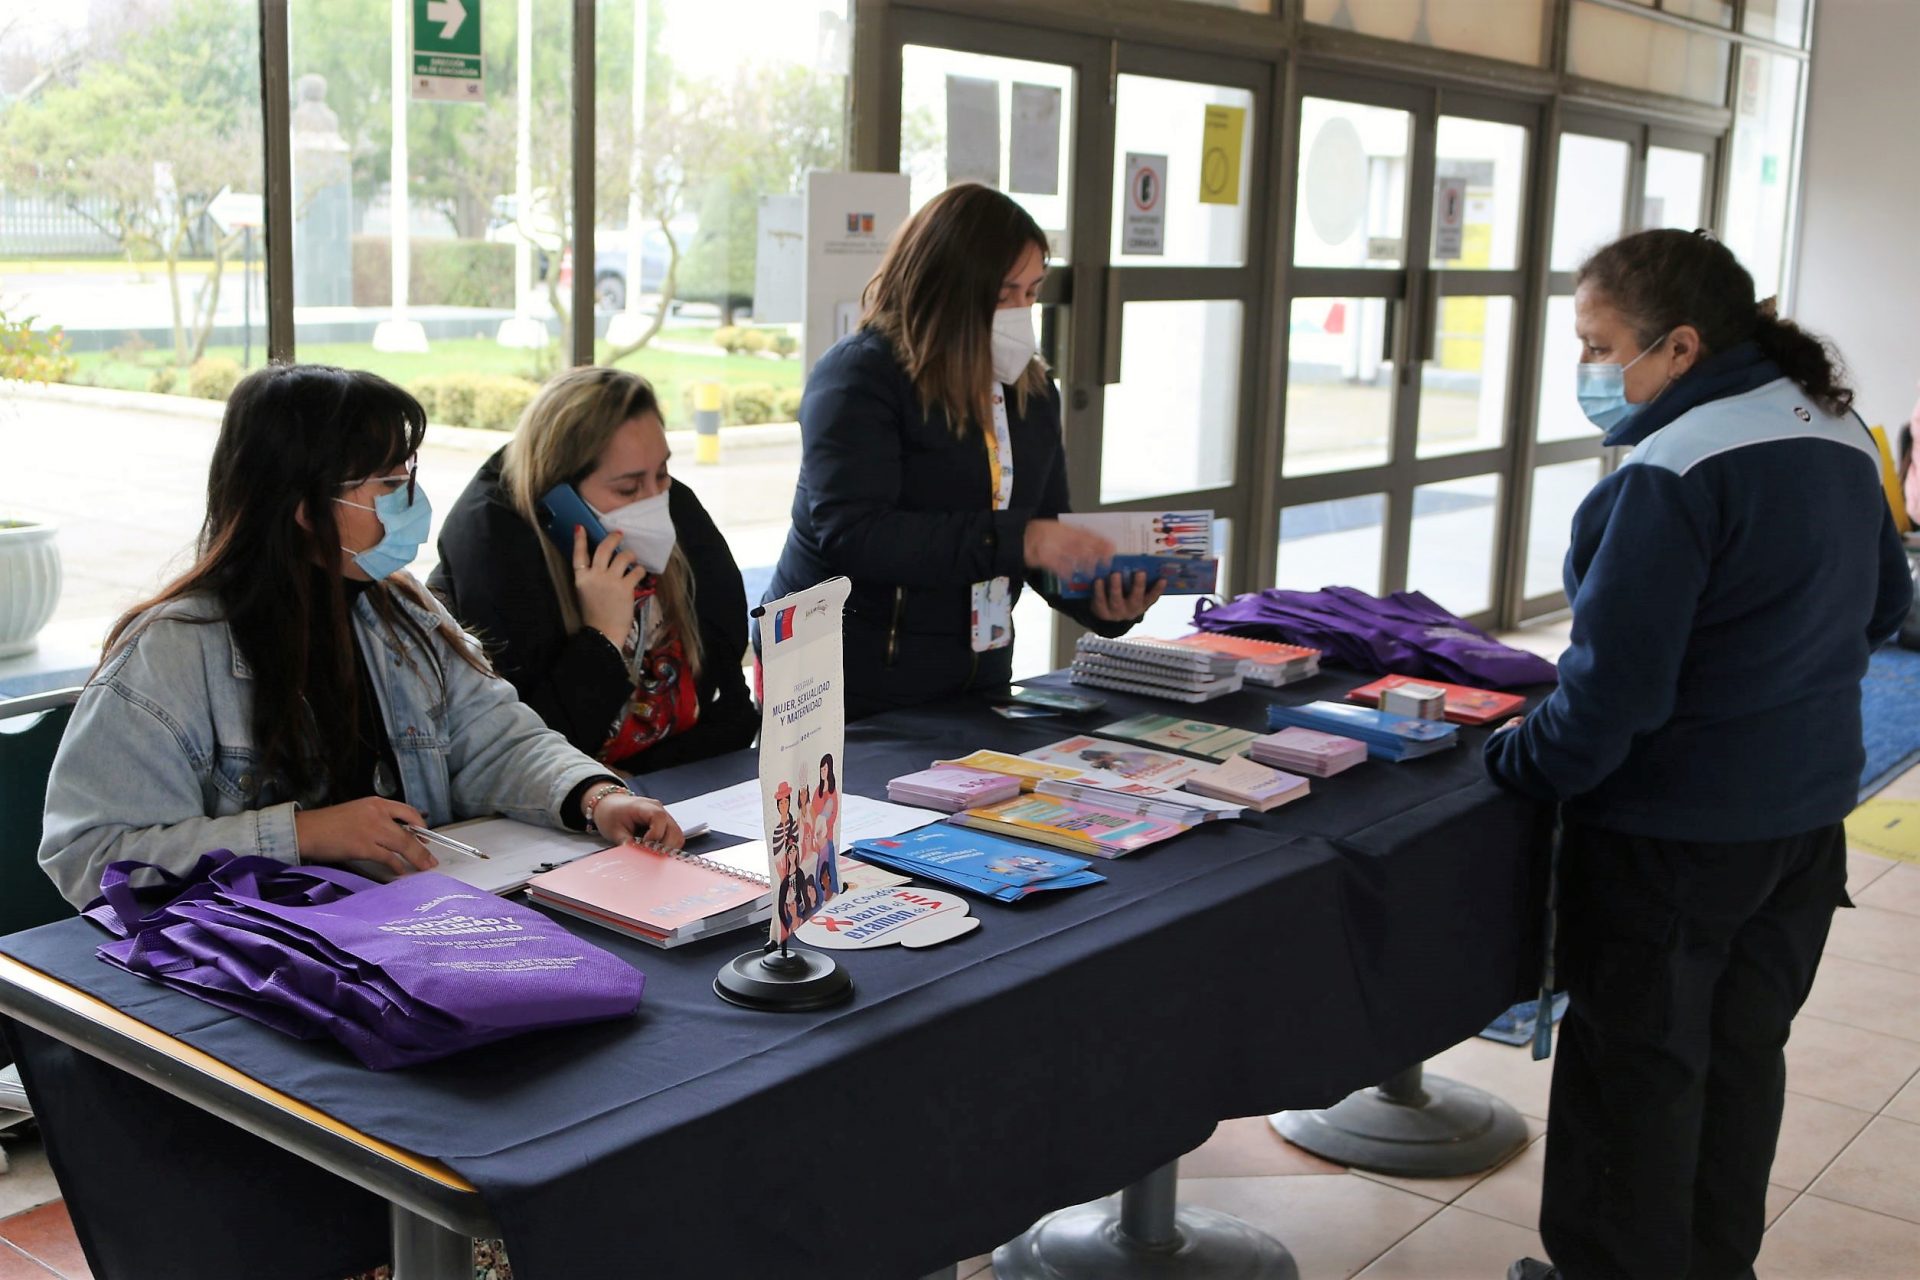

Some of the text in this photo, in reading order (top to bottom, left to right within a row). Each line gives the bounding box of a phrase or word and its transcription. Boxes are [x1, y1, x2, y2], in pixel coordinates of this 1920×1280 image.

[772, 680, 830, 717] MUJER, SEXUALIDAD
[780, 697, 823, 727] Y MATERNIDAD
[843, 910, 917, 939] examen
[845, 904, 893, 922] hazte
